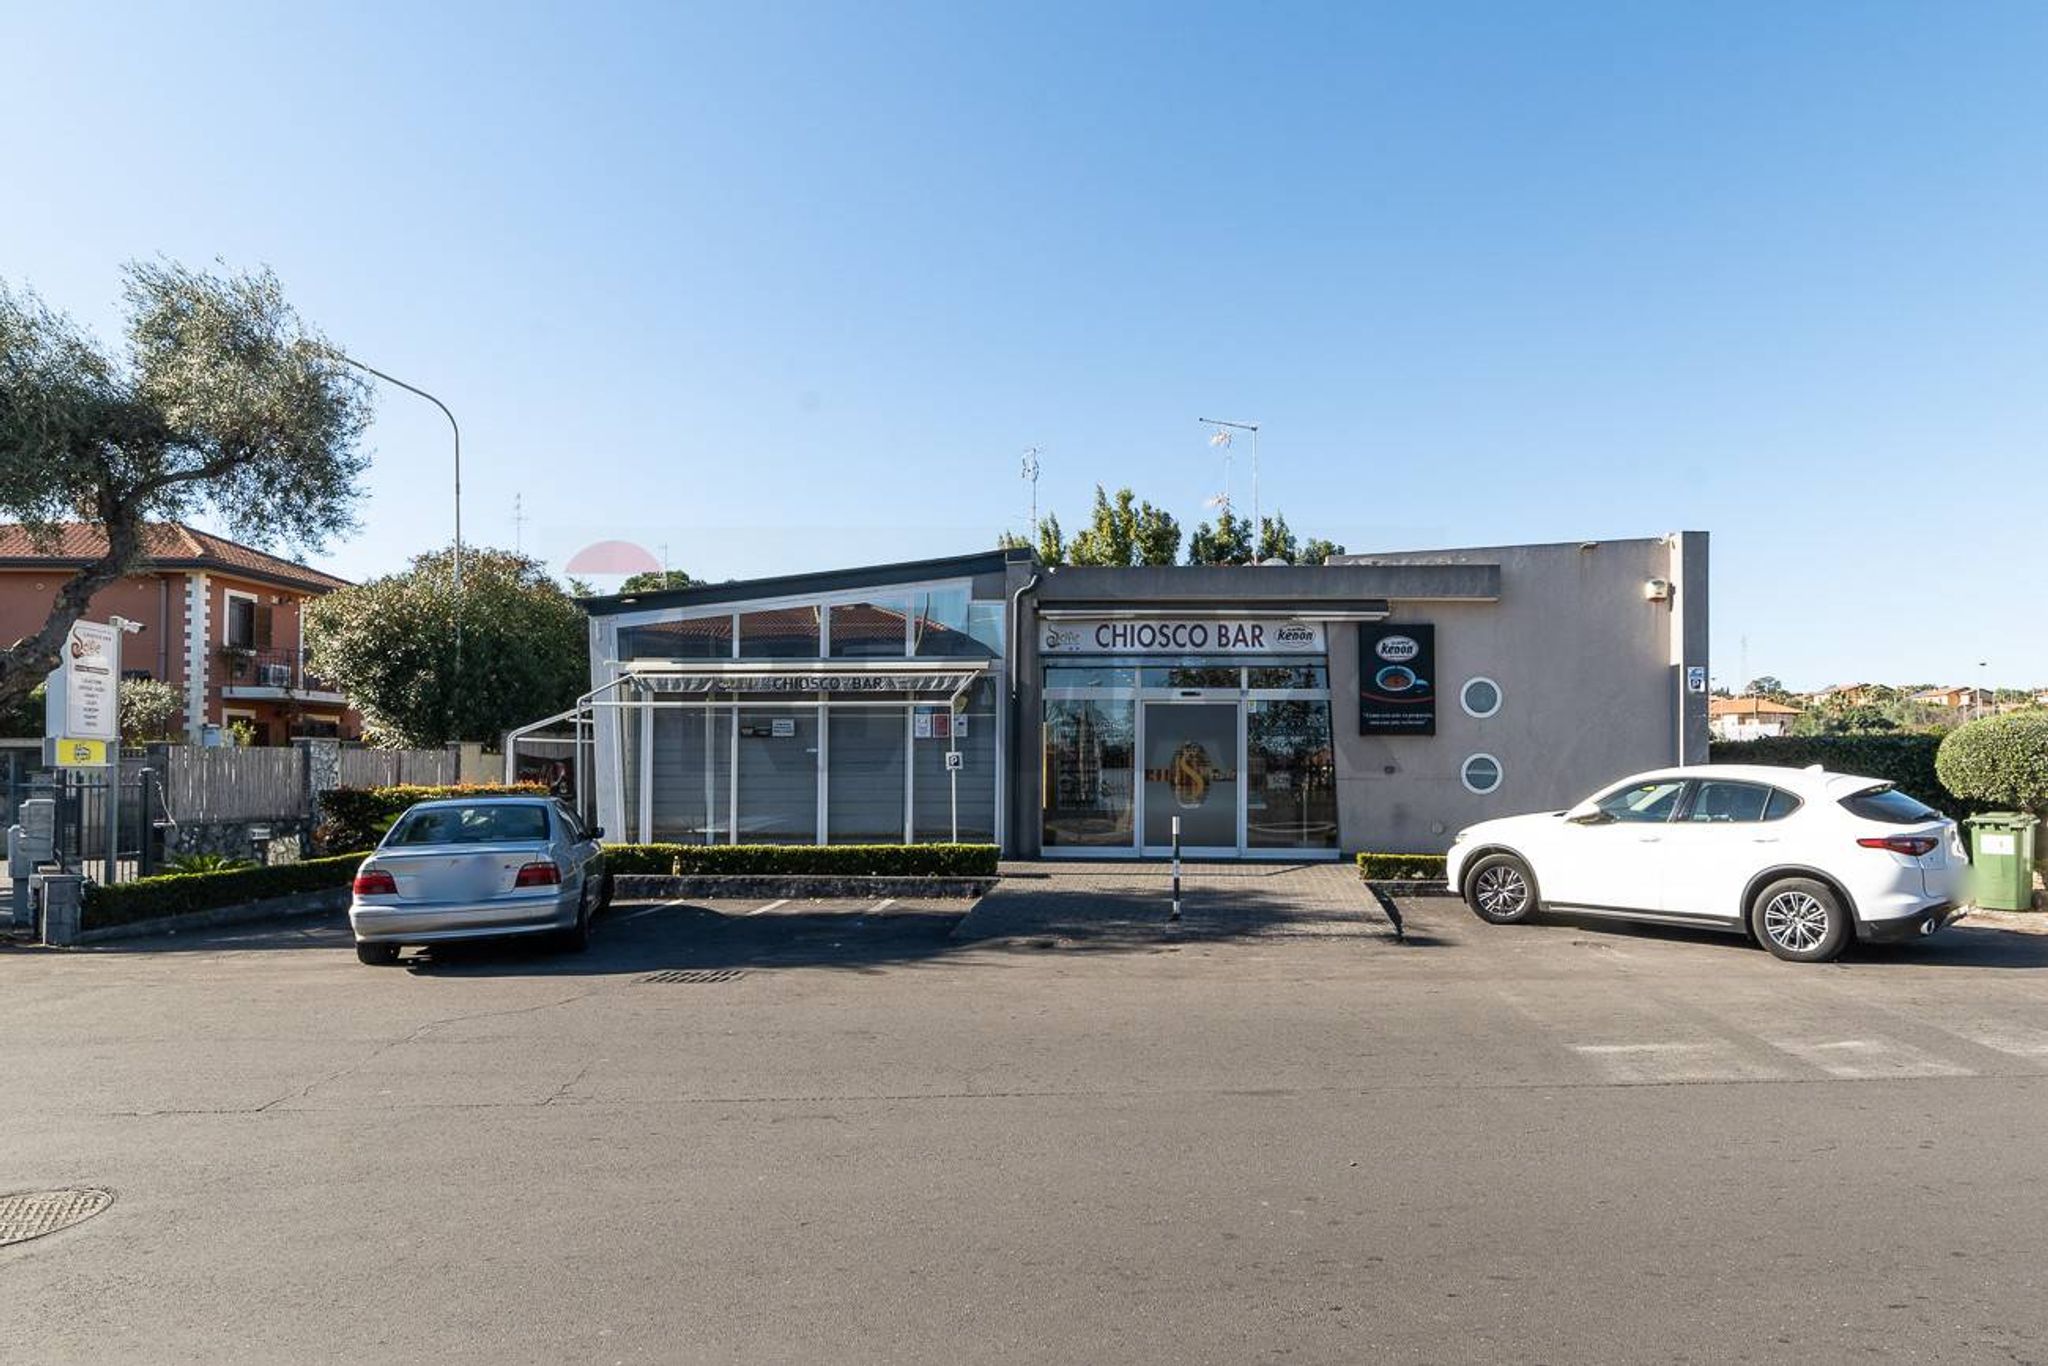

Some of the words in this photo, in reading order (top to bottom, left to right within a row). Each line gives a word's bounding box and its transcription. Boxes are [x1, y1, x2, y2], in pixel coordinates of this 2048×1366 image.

[1095, 624, 1208, 648] CHIOSCO
[1217, 624, 1265, 648] BAR
[773, 677, 841, 691] CHIOSCO
[852, 677, 884, 690] BAR
